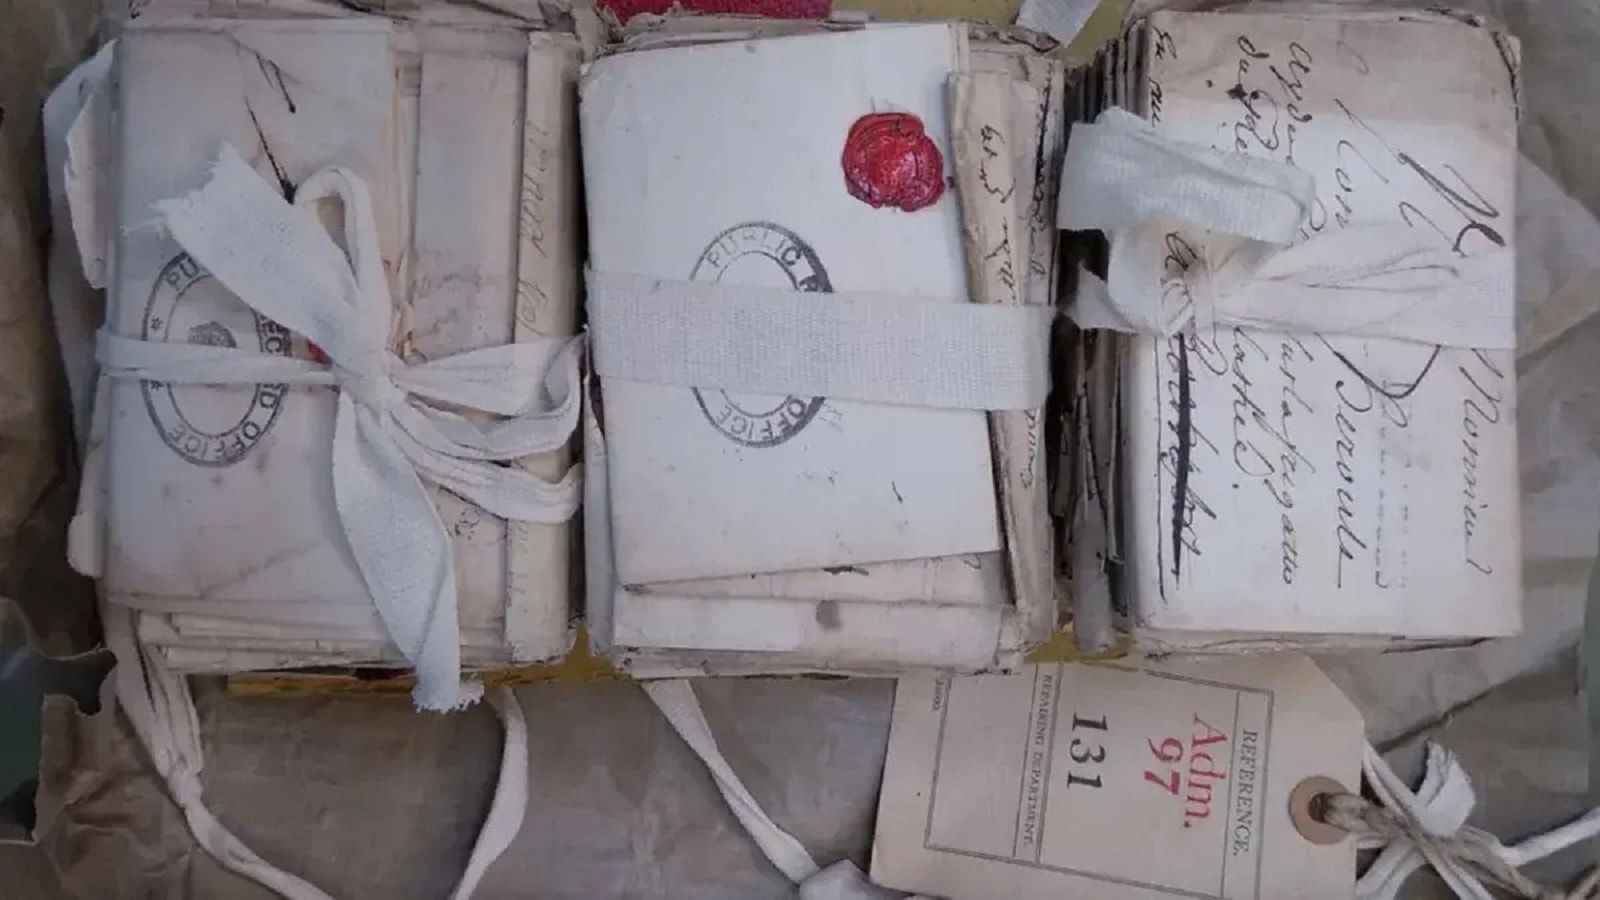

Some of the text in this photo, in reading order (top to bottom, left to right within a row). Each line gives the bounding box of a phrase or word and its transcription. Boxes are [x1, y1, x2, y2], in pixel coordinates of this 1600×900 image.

[706, 228, 801, 268] PUBLIC
[168, 420, 260, 461] OFFICE
[716, 398, 807, 441] OFFICE
[1021, 673, 1054, 847] REPAIRING DEPARTMENT.
[1065, 711, 1109, 791] 131
[1142, 734, 1185, 797] 97
[1182, 711, 1229, 830] Adm.
[1231, 728, 1260, 857] REFERENCE.
